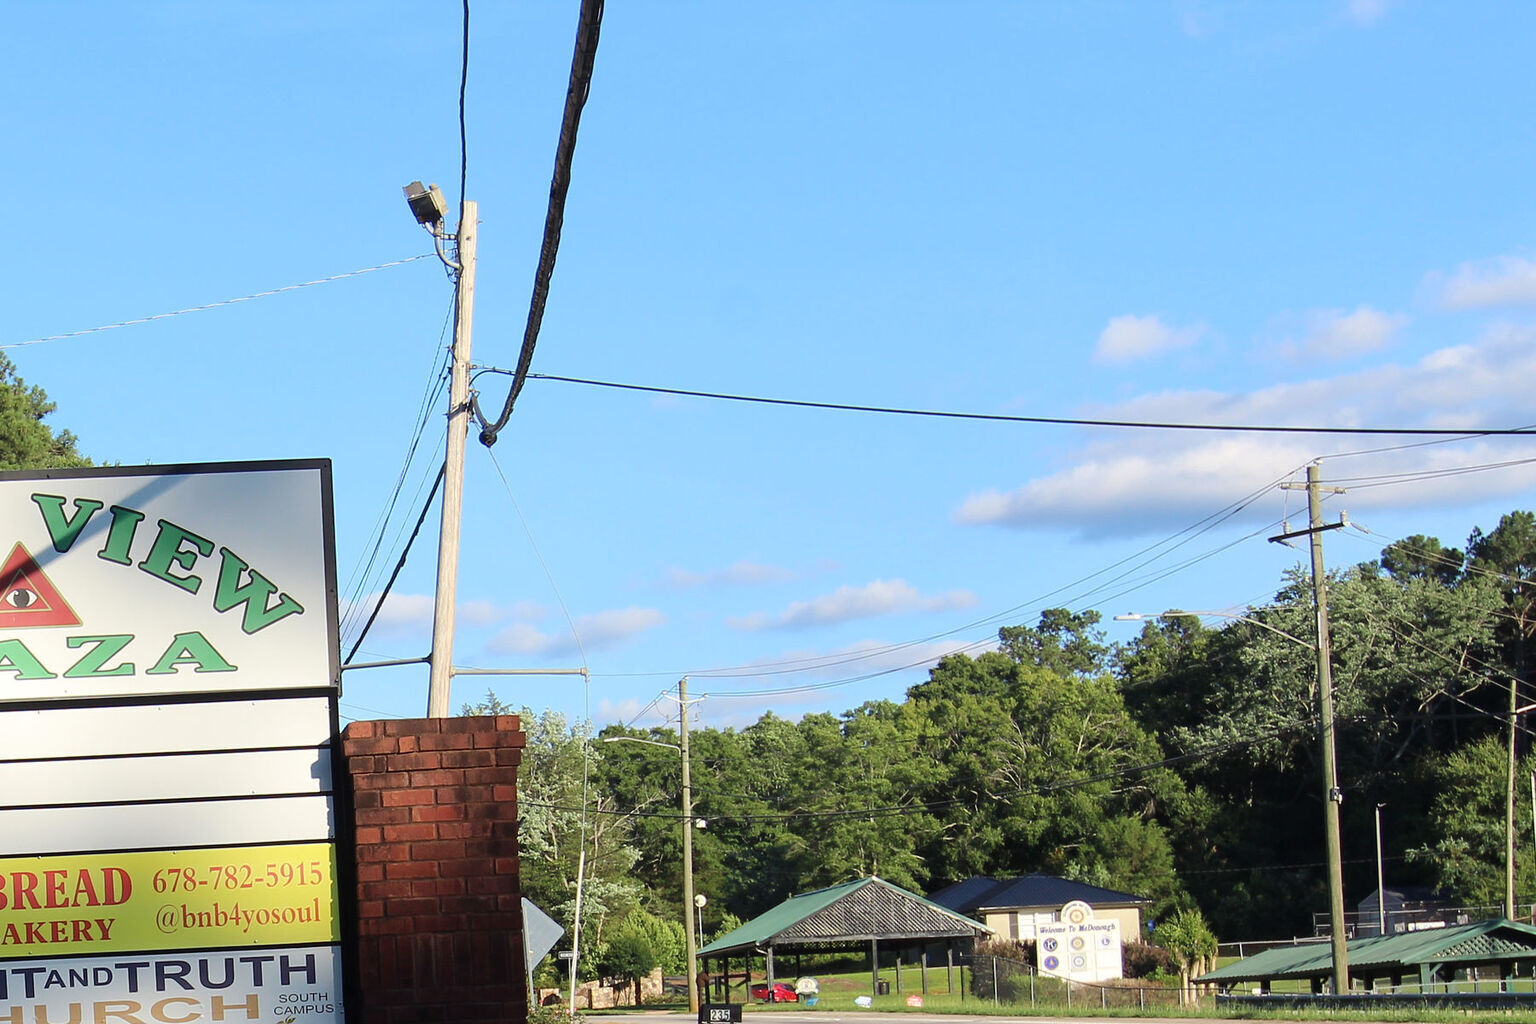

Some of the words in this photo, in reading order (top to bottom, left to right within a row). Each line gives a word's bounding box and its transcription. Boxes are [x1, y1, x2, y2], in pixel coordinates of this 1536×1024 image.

[30, 492, 305, 636] VIEW
[152, 861, 323, 893] 678-782-5915
[156, 897, 321, 934] @bnb4yosoul
[279, 992, 328, 1004] SOUTH
[274, 1004, 335, 1016] CAMPUS
[711, 1010, 729, 1020] 235
